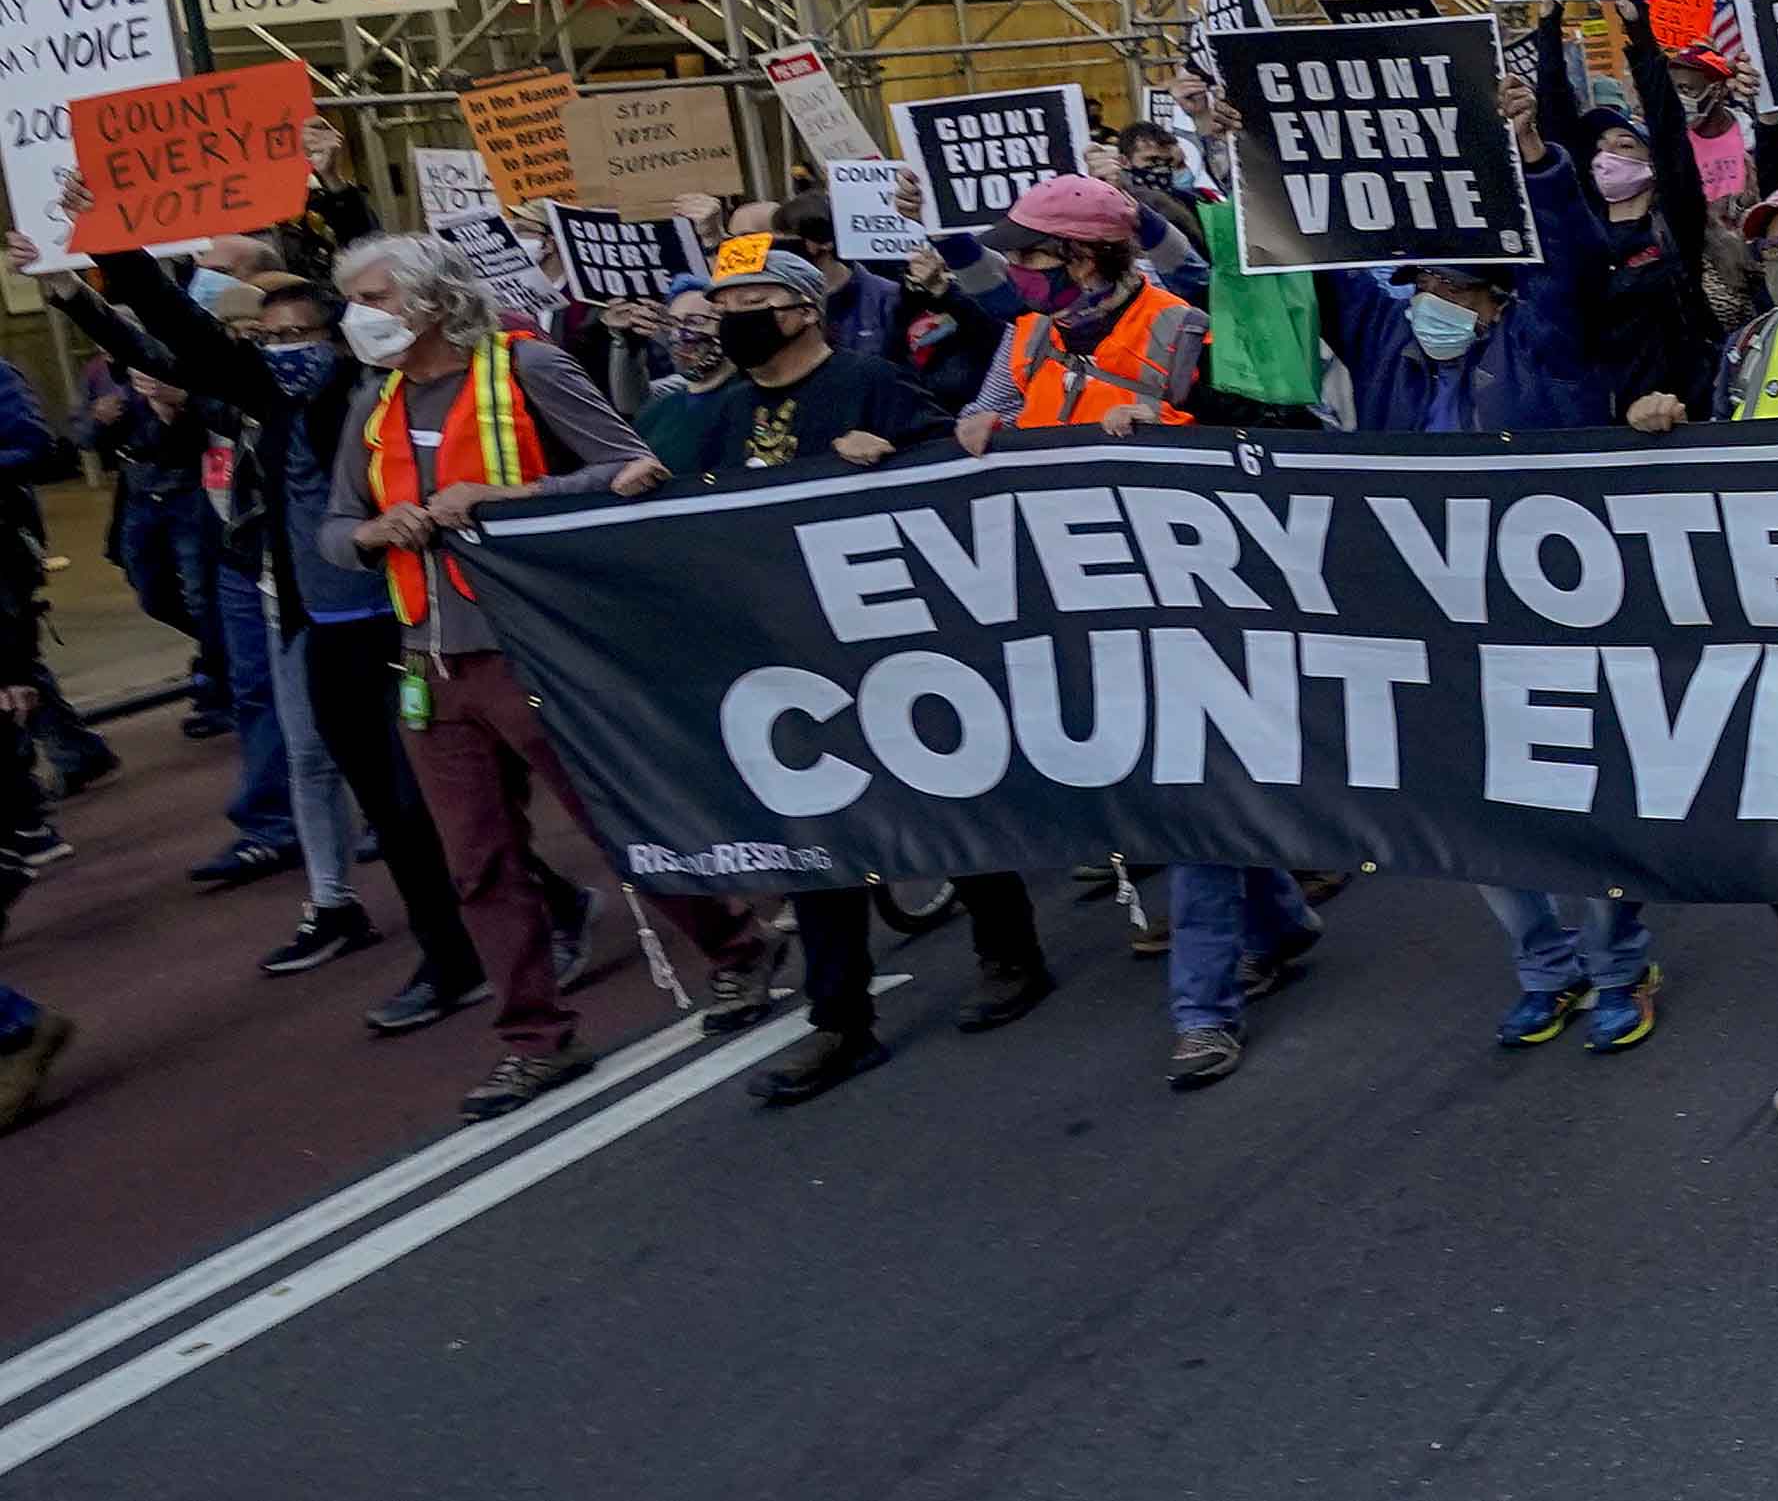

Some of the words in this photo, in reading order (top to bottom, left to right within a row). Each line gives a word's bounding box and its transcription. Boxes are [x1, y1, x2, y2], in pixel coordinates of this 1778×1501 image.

[47, 17, 152, 75] VOICE
[1256, 54, 1451, 102] COUNT
[97, 81, 238, 144] COUNT
[933, 108, 1046, 142] COUNT
[1269, 106, 1462, 163] EVERY
[106, 124, 257, 190] EVERY
[941, 135, 1052, 175] EVERY
[117, 174, 252, 234] VOTE
[567, 219, 656, 243] COUNT
[1283, 170, 1488, 235] VOTE
[572, 242, 663, 269] EVERY
[581, 267, 672, 296] VOTE
[1236, 442, 1263, 476] 6'
[795, 484, 1343, 646] EVERY
[718, 625, 1432, 821] COUNT
